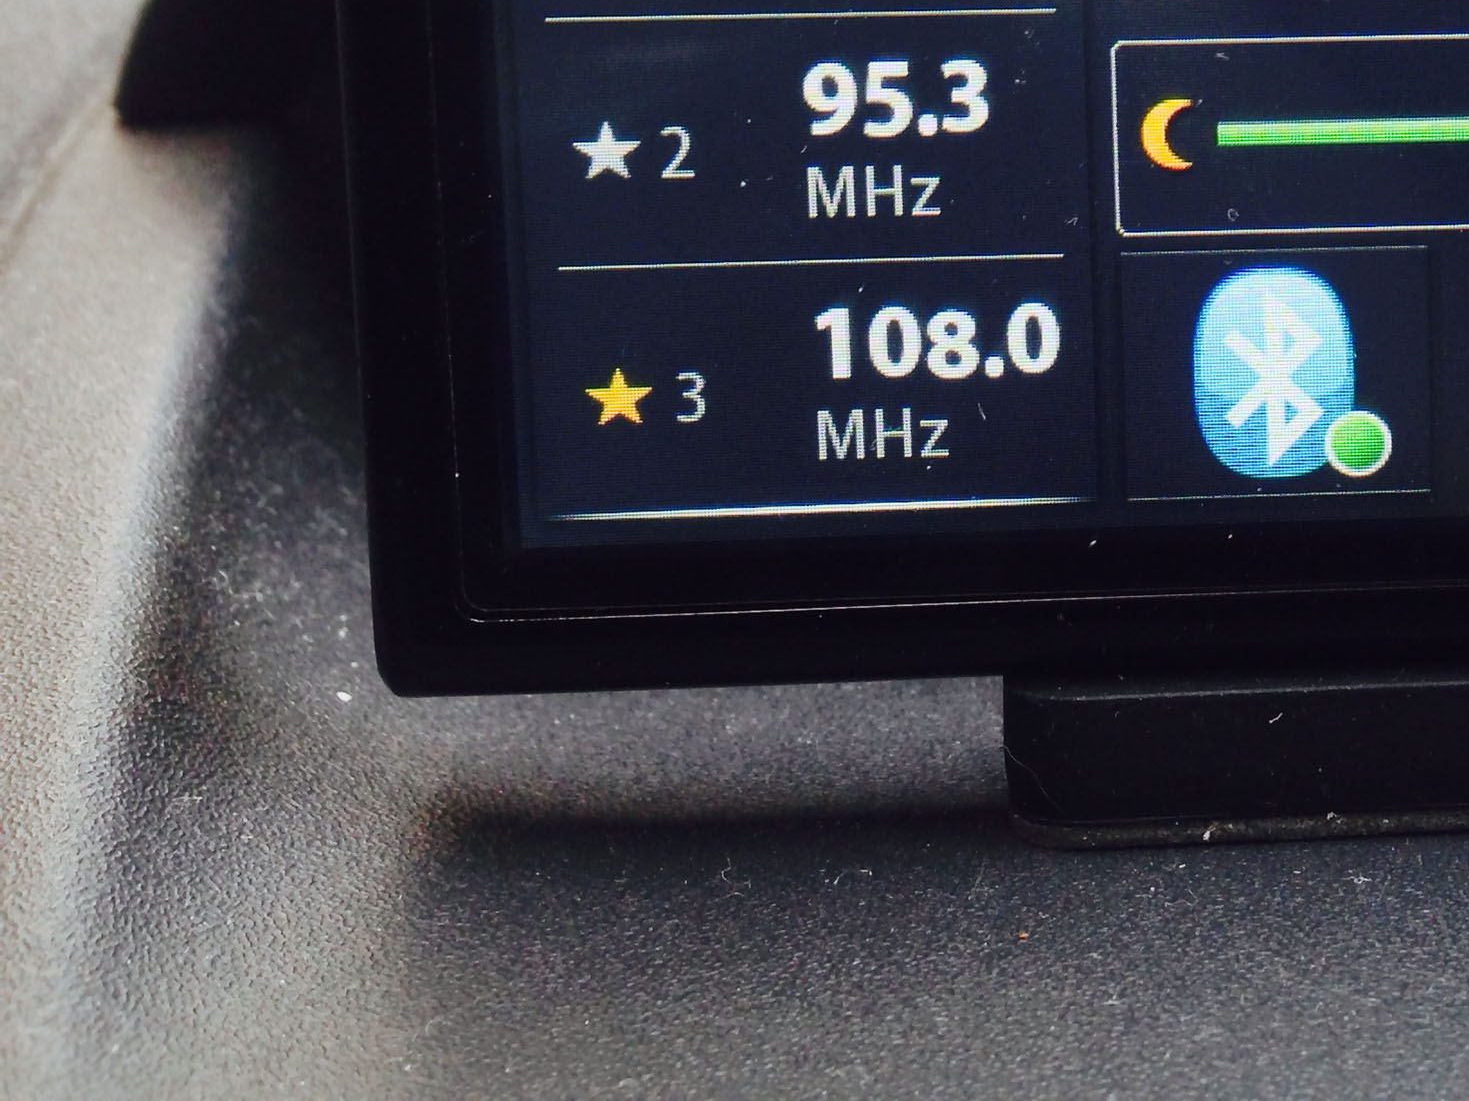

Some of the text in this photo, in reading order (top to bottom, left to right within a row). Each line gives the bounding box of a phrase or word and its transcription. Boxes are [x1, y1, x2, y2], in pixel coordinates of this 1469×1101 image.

[803, 59, 990, 137] 95.3
[661, 126, 694, 178] 2
[807, 165, 941, 217] MHz
[815, 302, 1060, 379] 108.0
[676, 372, 706, 422] 3
[817, 408, 950, 459] MHz
